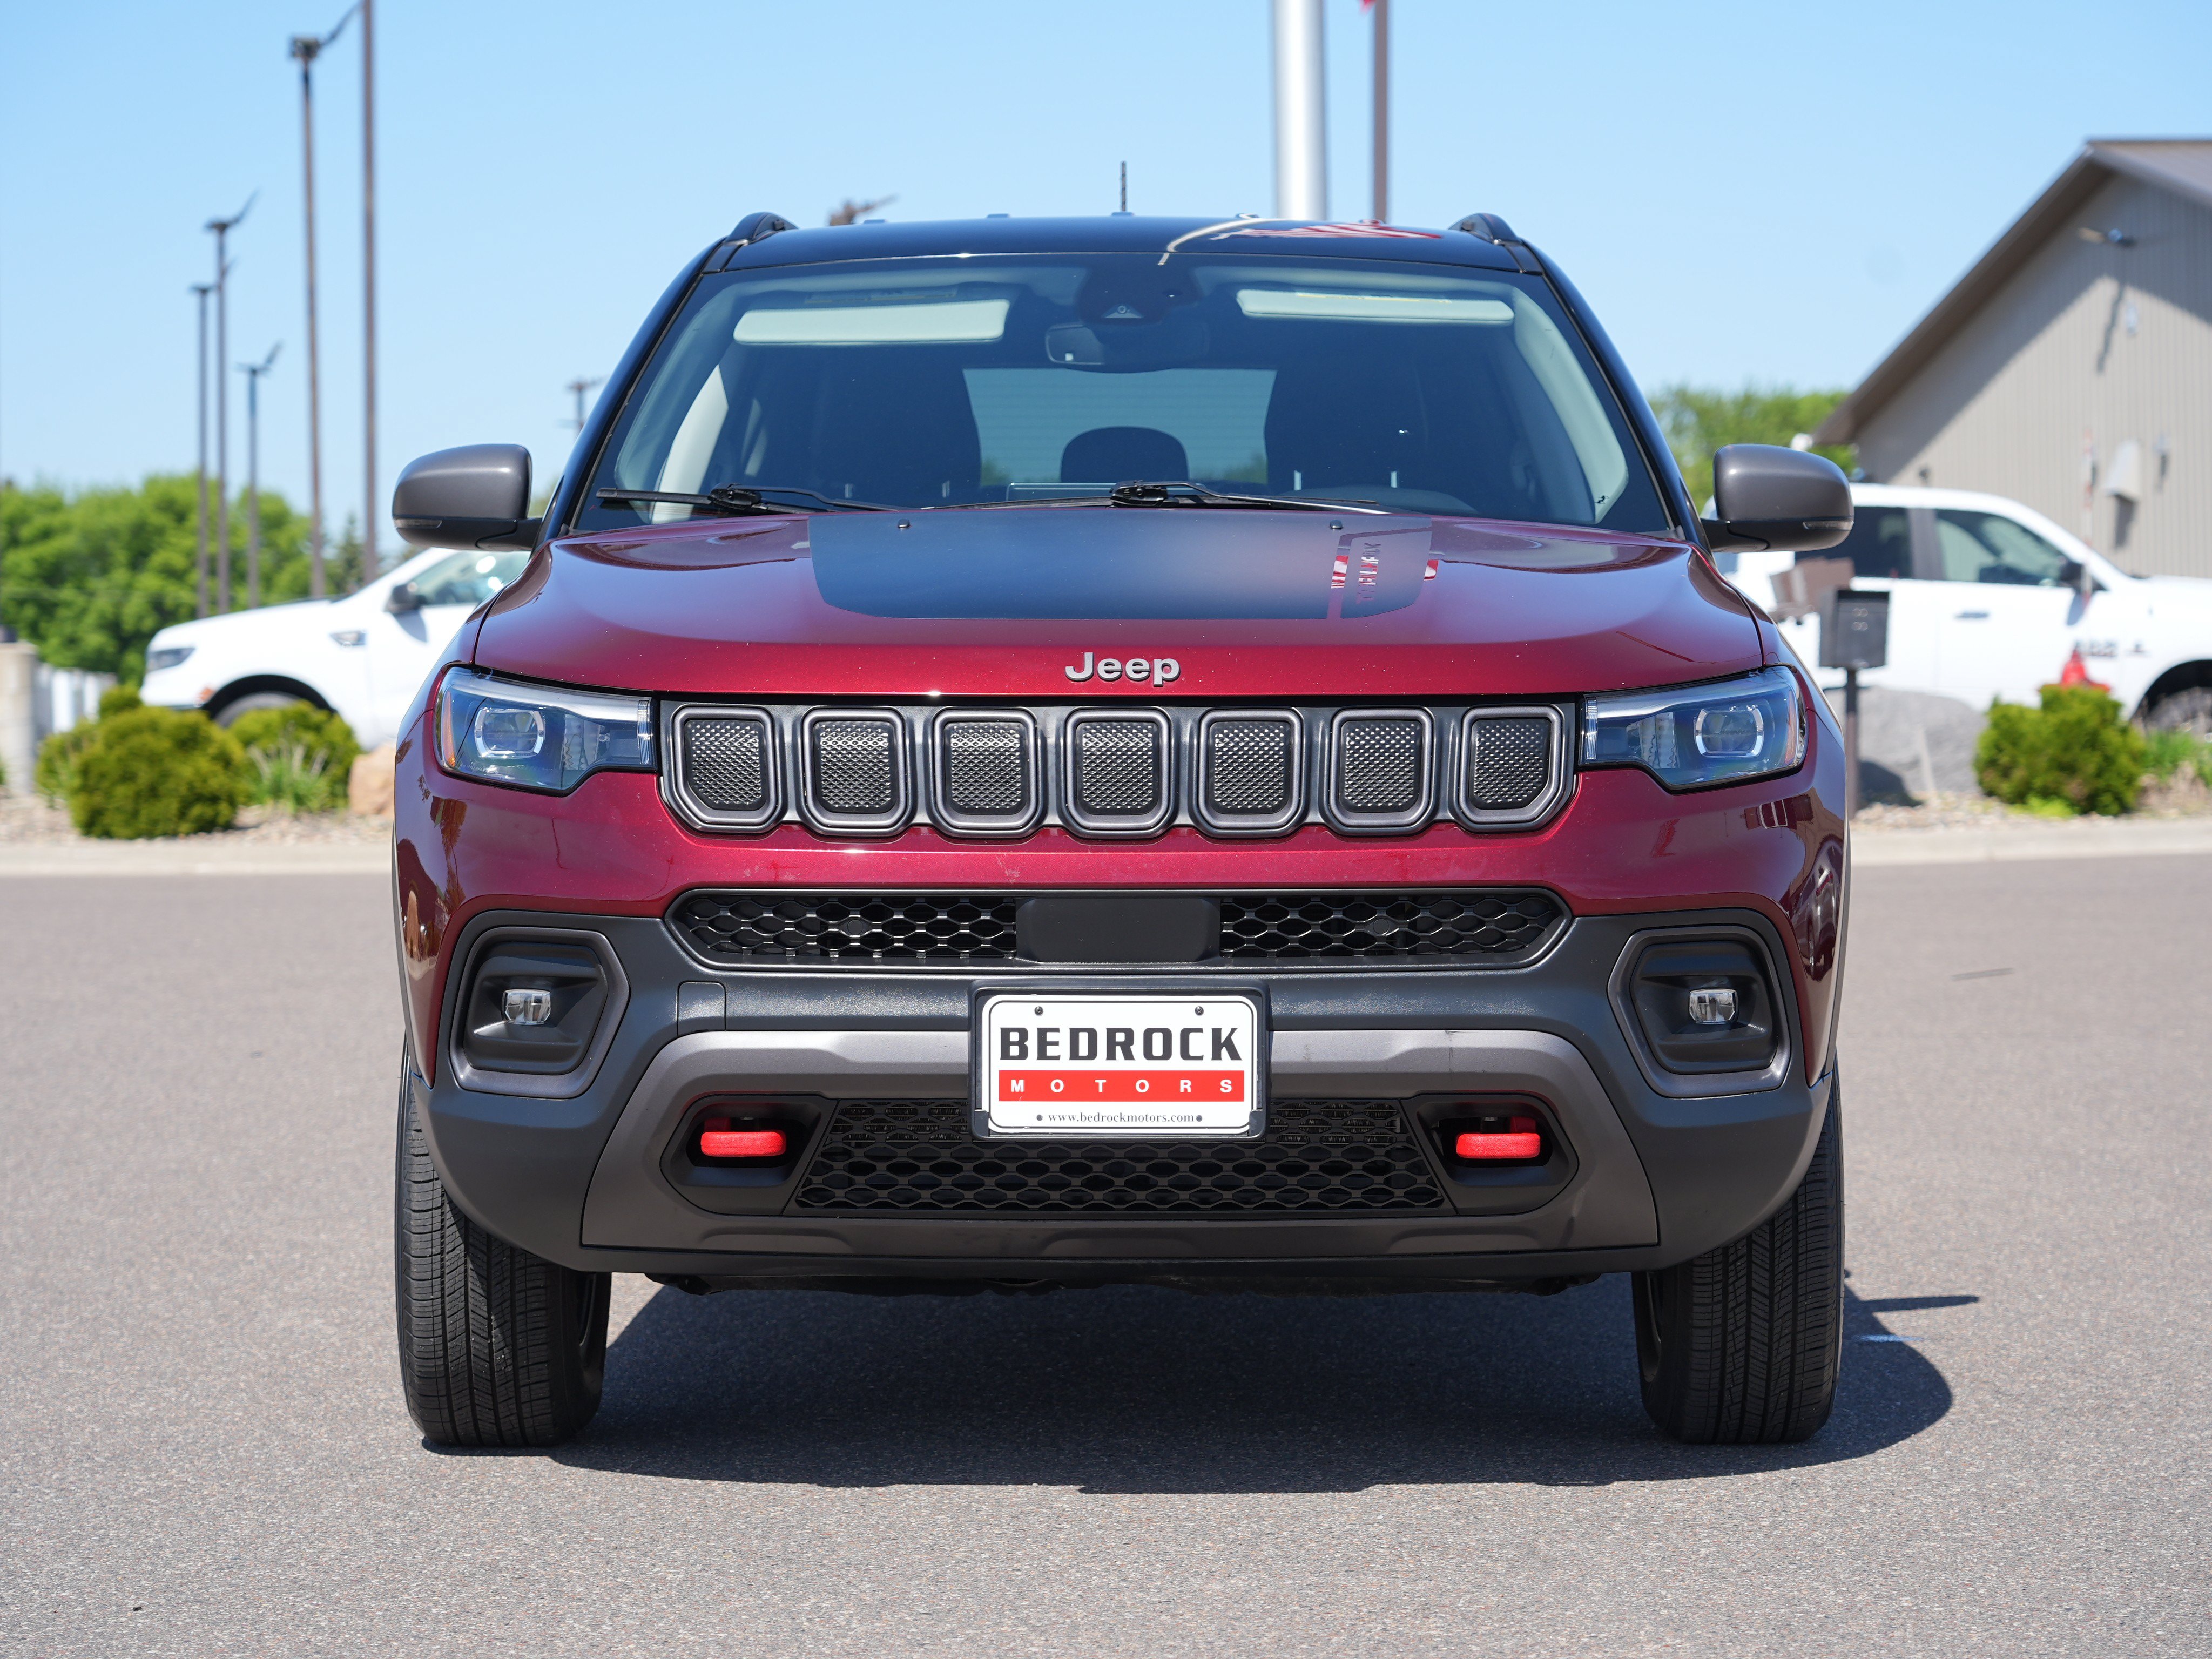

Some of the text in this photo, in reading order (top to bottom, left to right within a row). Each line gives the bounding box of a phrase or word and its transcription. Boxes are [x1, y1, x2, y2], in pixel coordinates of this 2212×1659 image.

[1064, 651, 1181, 687] Jeep
[1000, 1027, 1242, 1061] BEDROCK
[1010, 1078, 1232, 1093] MOTORS
[1048, 1112, 1194, 1122] www.bedrockmotors.com
